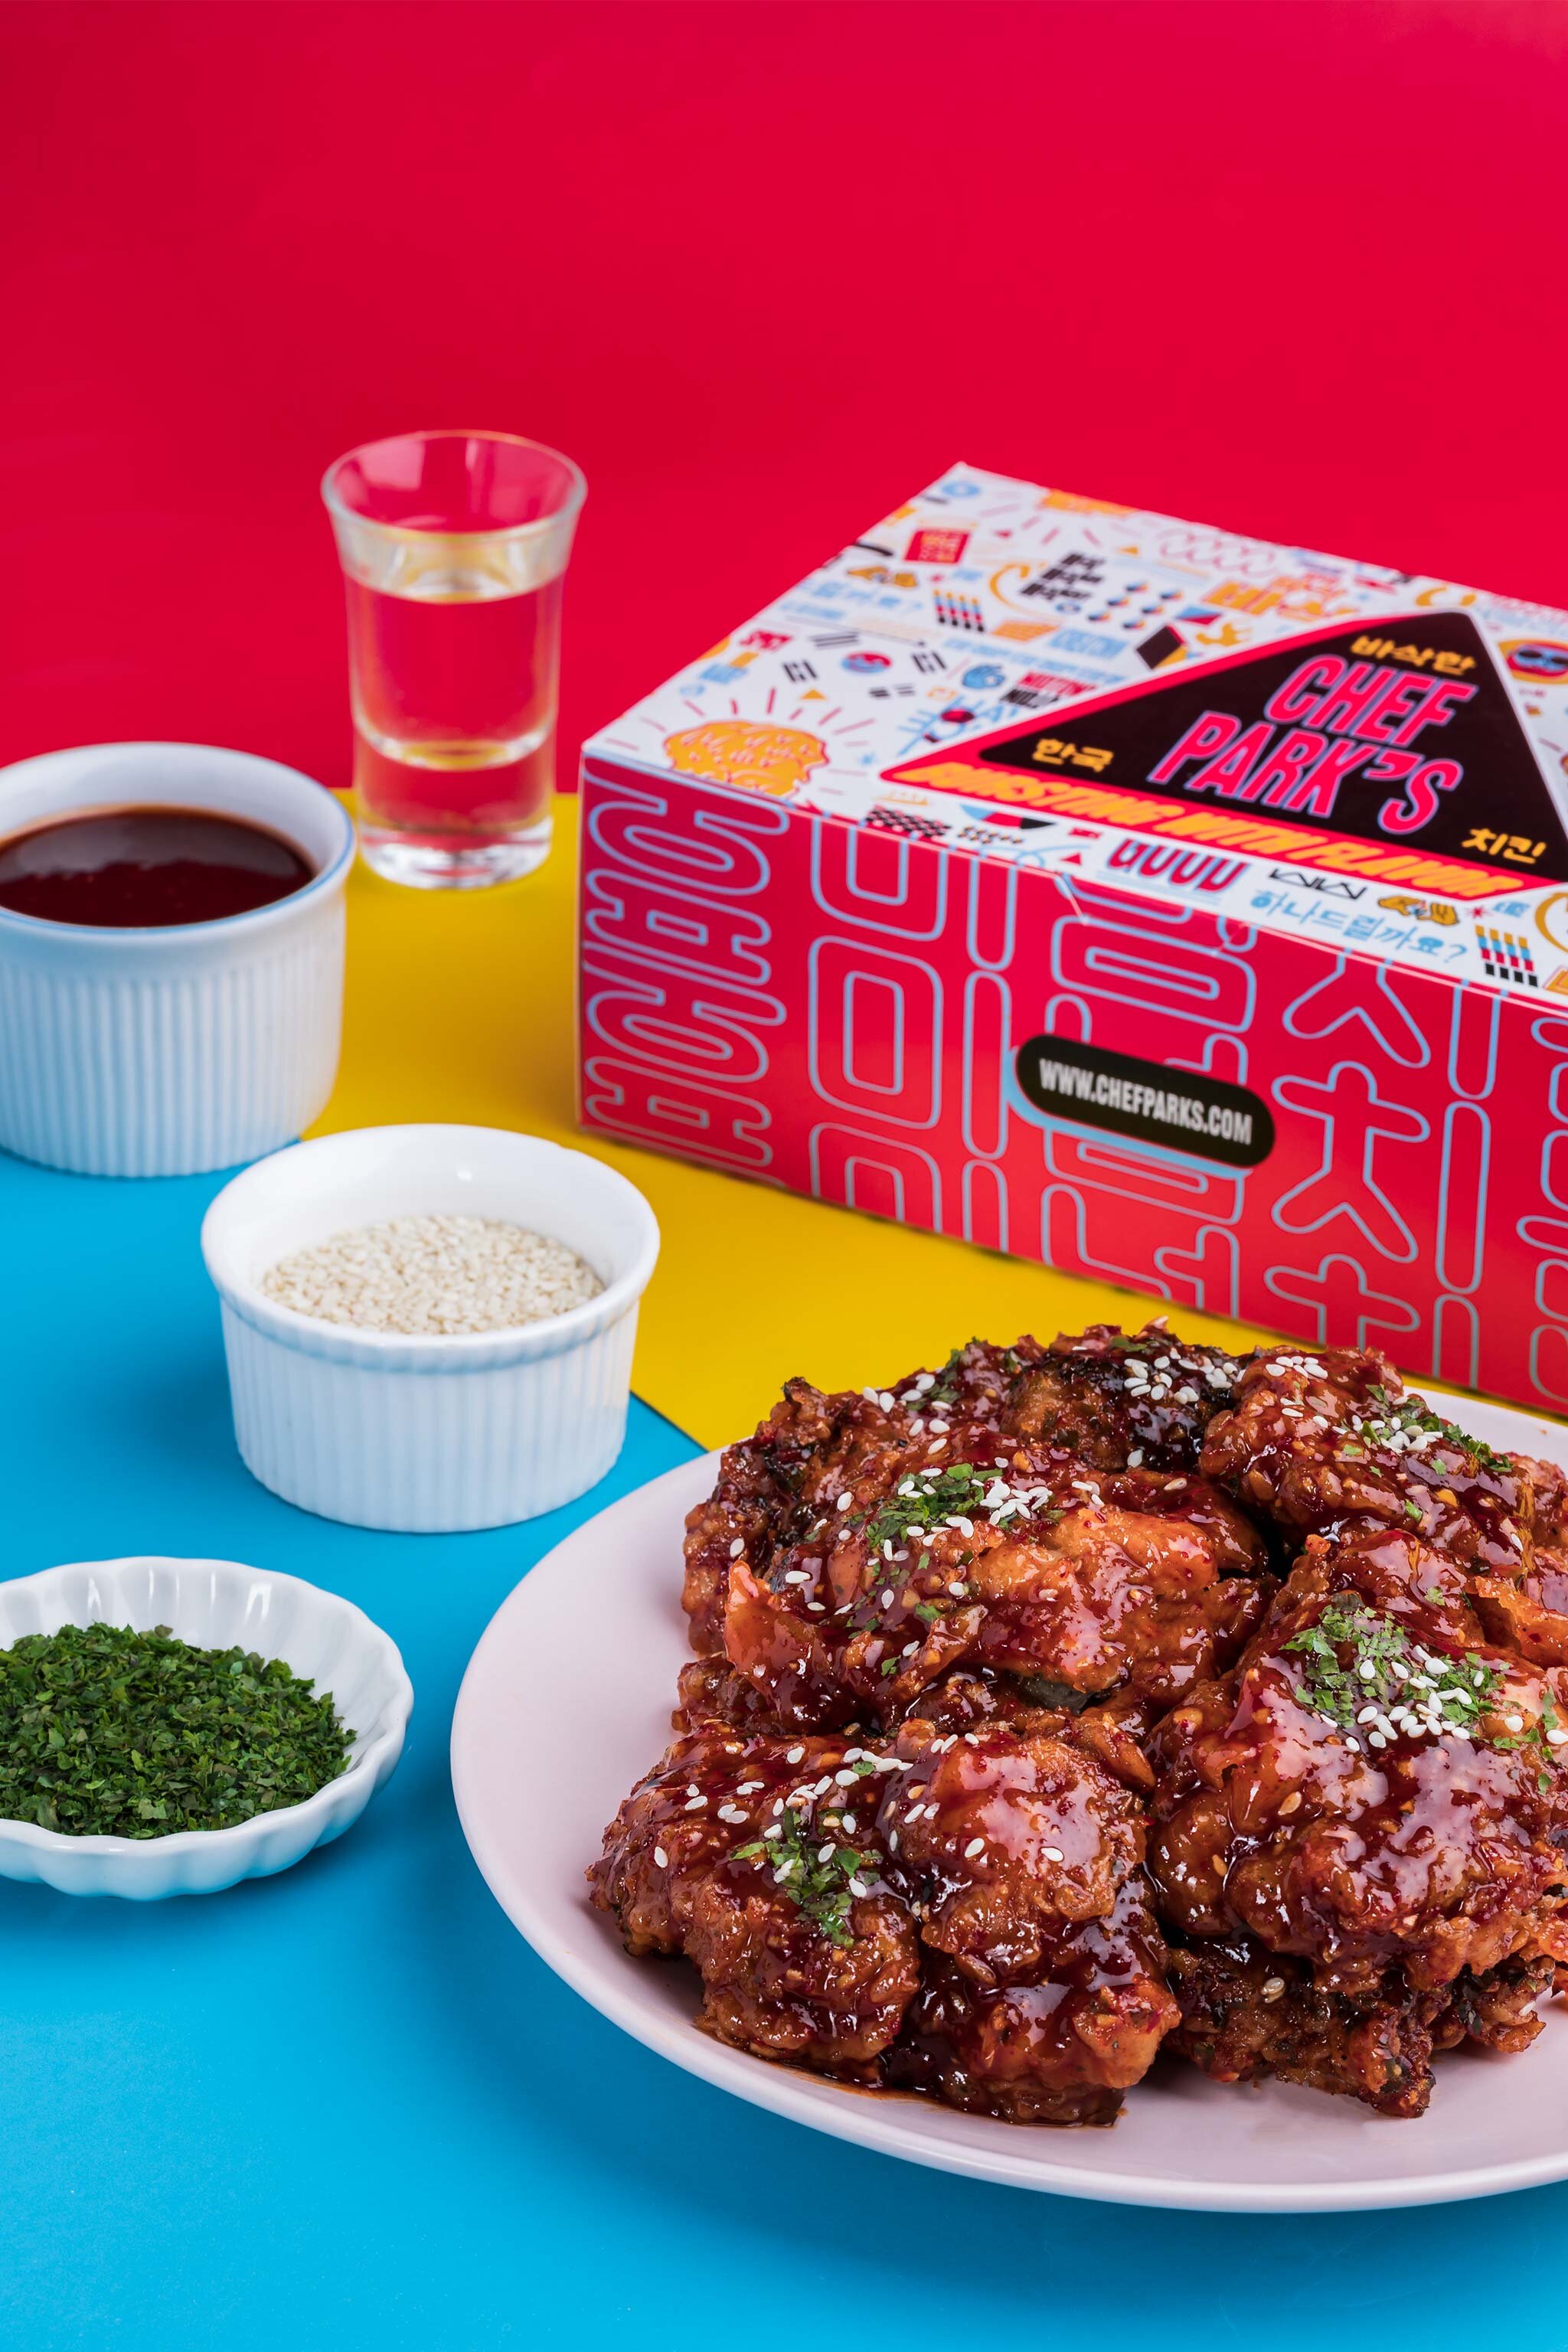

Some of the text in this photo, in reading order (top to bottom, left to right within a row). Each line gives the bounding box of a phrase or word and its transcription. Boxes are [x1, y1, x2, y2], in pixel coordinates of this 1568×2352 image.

[1350, 634, 1478, 676] 바삭한
[1263, 653, 1480, 747] CHEF
[1031, 737, 1115, 773] 한국
[1146, 709, 1465, 835] PARK'S
[891, 761, 1524, 898] BURSTING WITH FLAVOR
[1461, 827, 1547, 865] 치킨
[1038, 1057, 1253, 1145] WWW.CHEFPARKS.COM
